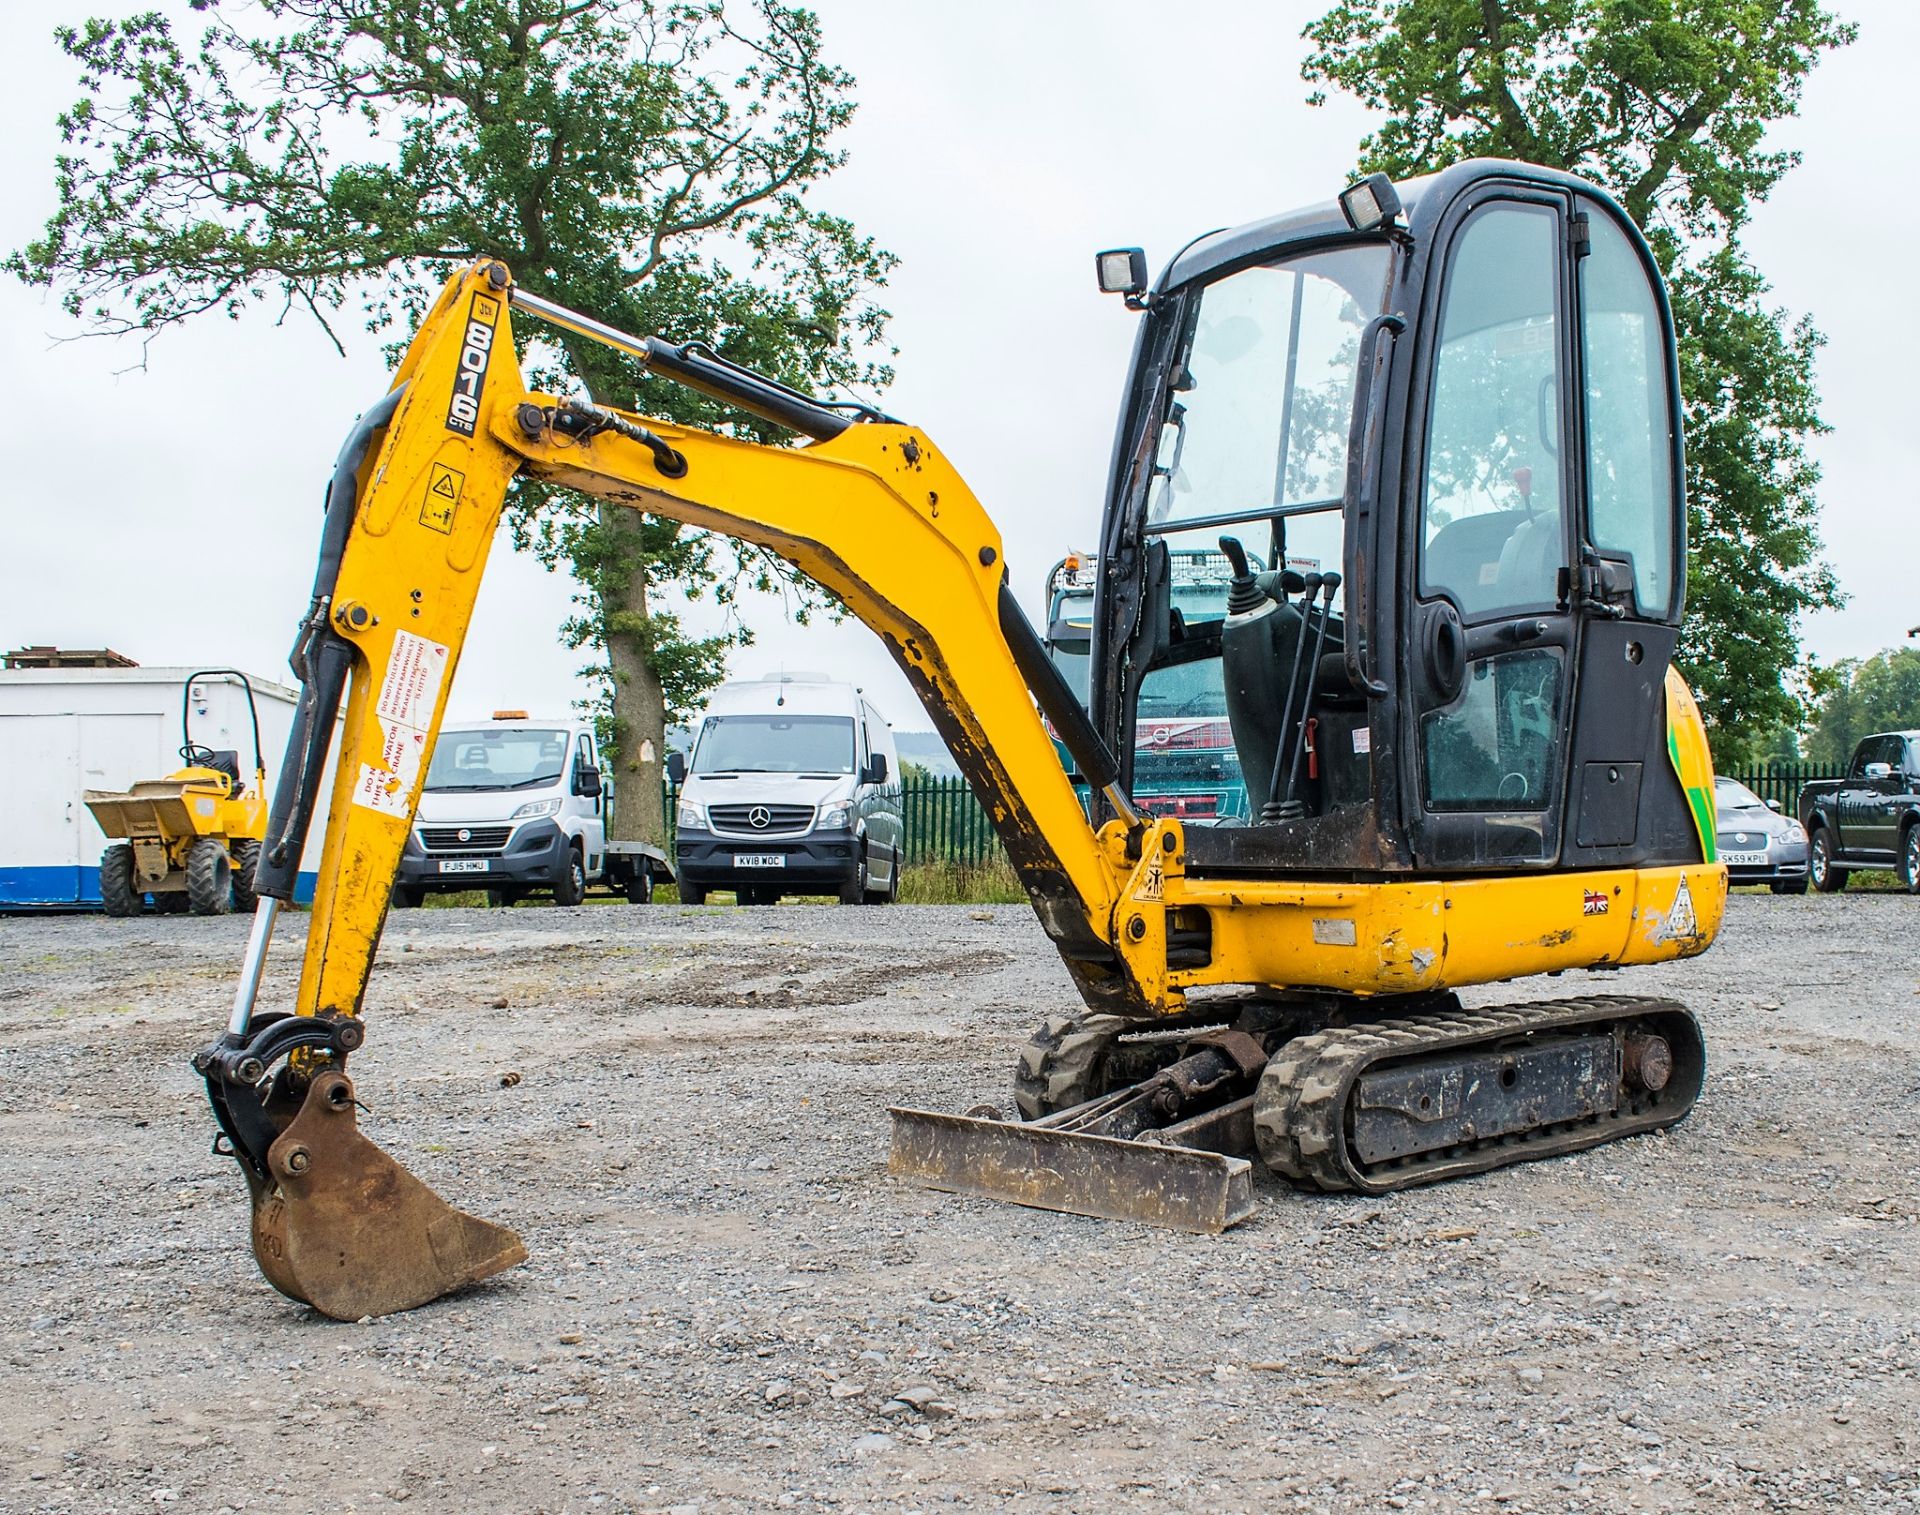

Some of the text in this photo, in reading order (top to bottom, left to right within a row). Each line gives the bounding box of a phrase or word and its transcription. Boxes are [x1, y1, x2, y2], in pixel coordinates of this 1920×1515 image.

[451, 321, 493, 424] 8016
[448, 416, 474, 432] CTS
[381, 635, 406, 712] DO NOT FULLY CROWD
[400, 641, 425, 719] BREAKER ATTACHMENT
[417, 667, 428, 693] FITTED
[395, 682, 403, 707] DIPPER
[392, 741, 405, 775] CRANE
[364, 777, 374, 793] DO
[371, 784, 383, 806] THIS
[444, 862, 465, 871] FJ15
[739, 856, 780, 866] KV18 WOC
[1721, 854, 1765, 864] SK59 KPU
